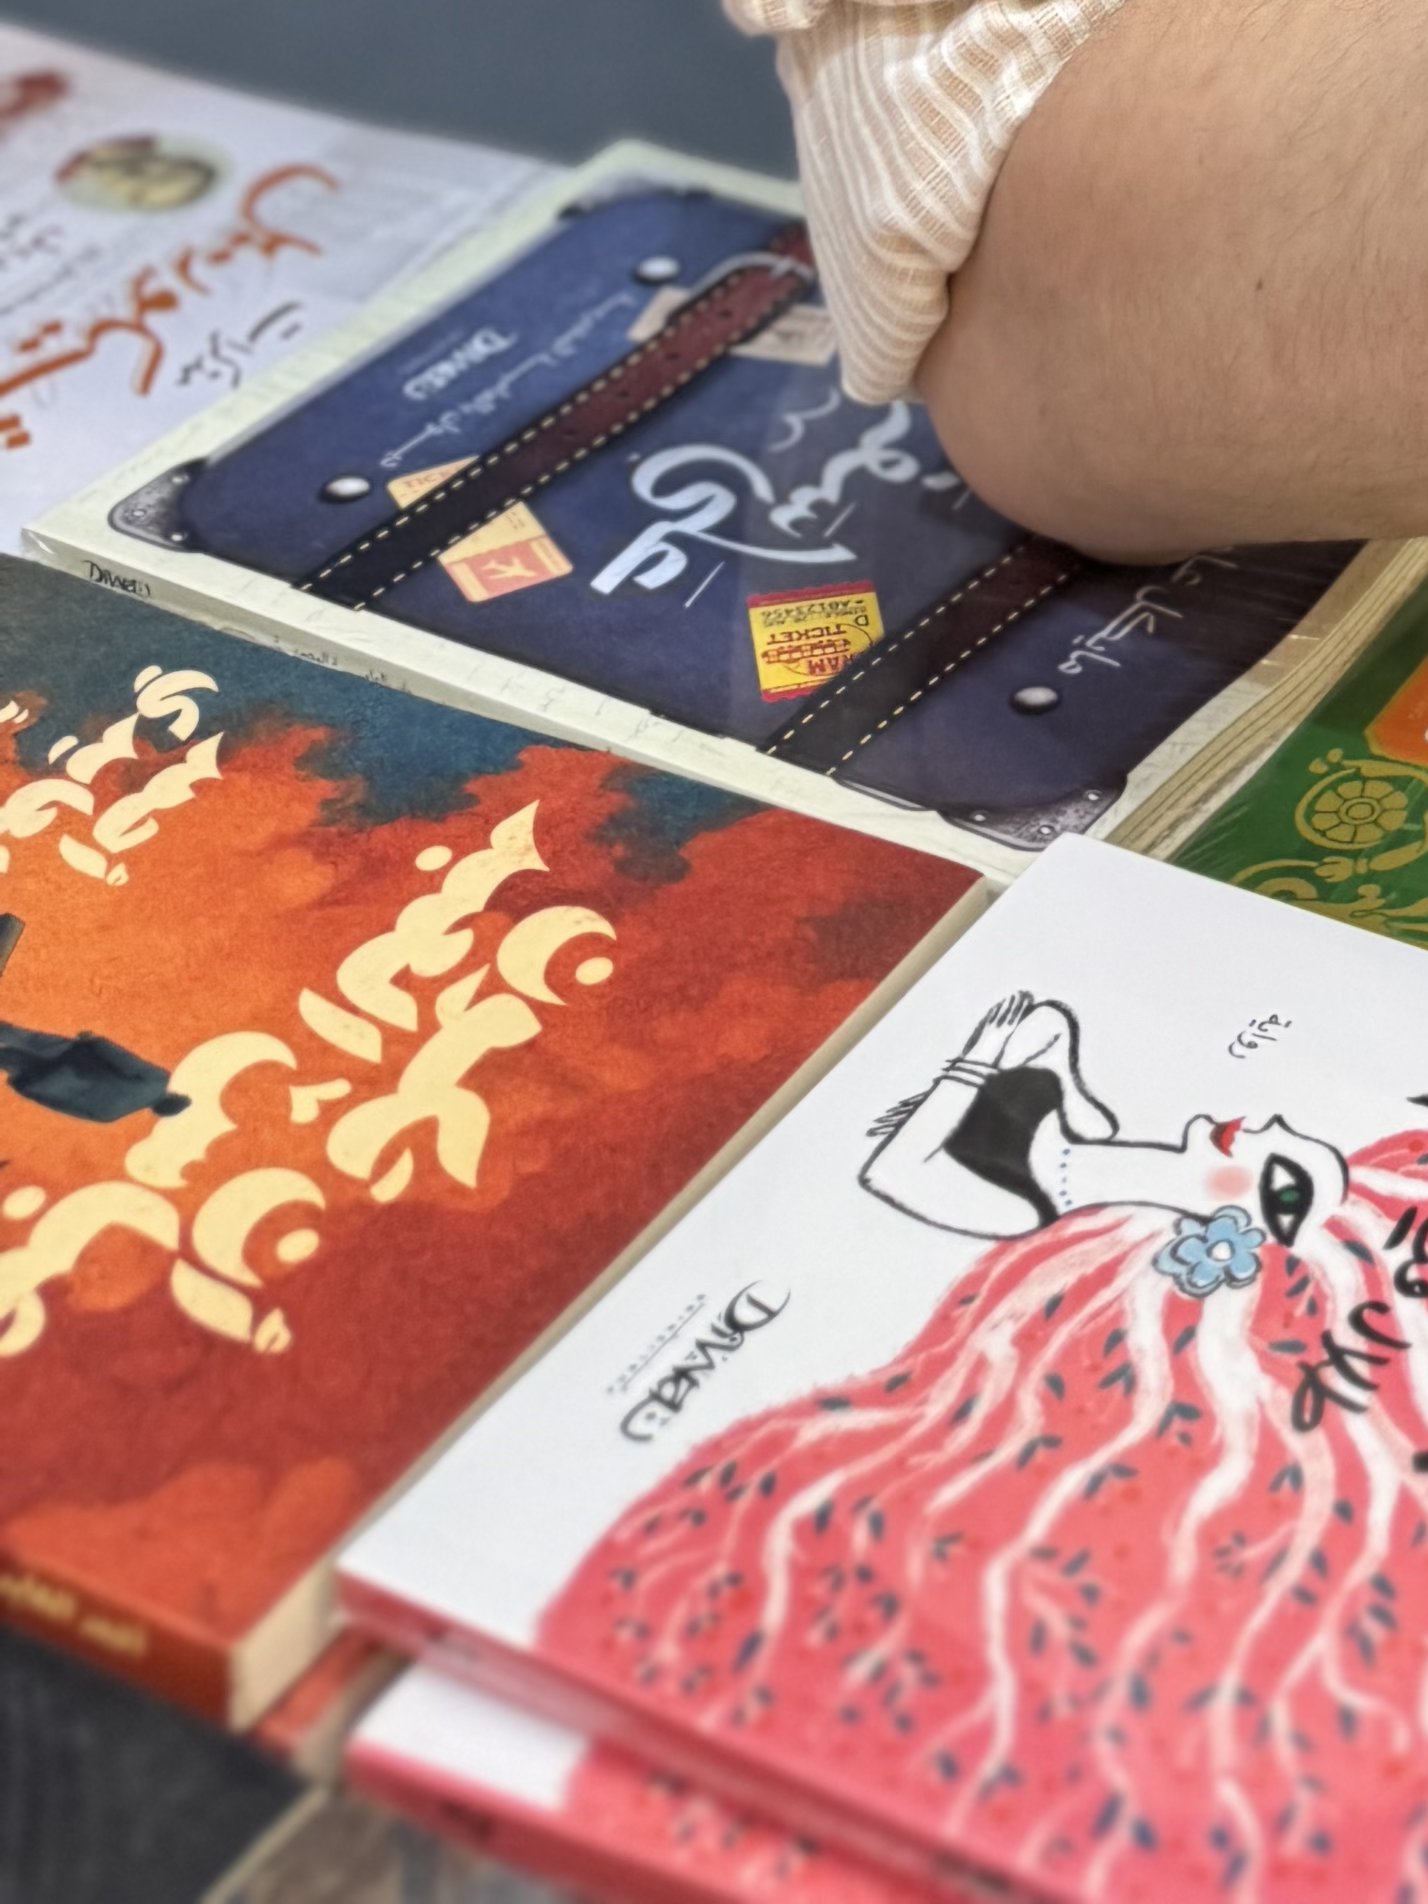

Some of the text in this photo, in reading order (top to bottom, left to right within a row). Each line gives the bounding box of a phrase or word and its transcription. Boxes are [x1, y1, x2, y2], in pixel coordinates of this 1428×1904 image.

[177, 299, 304, 389] مذكرات
[766, 624, 847, 646] TICKET
[1058, 585, 1184, 676] مايكل
[0, 664, 220, 873] عايدي
[58, 729, 225, 886] أحمد
[0, 798, 550, 1359] عباس العبد
[1227, 1011, 1293, 1059] رواية
[170, 1165, 328, 1355] أن
[326, 904, 619, 1205] تكون
[1291, 1301, 1412, 1434] طلال
